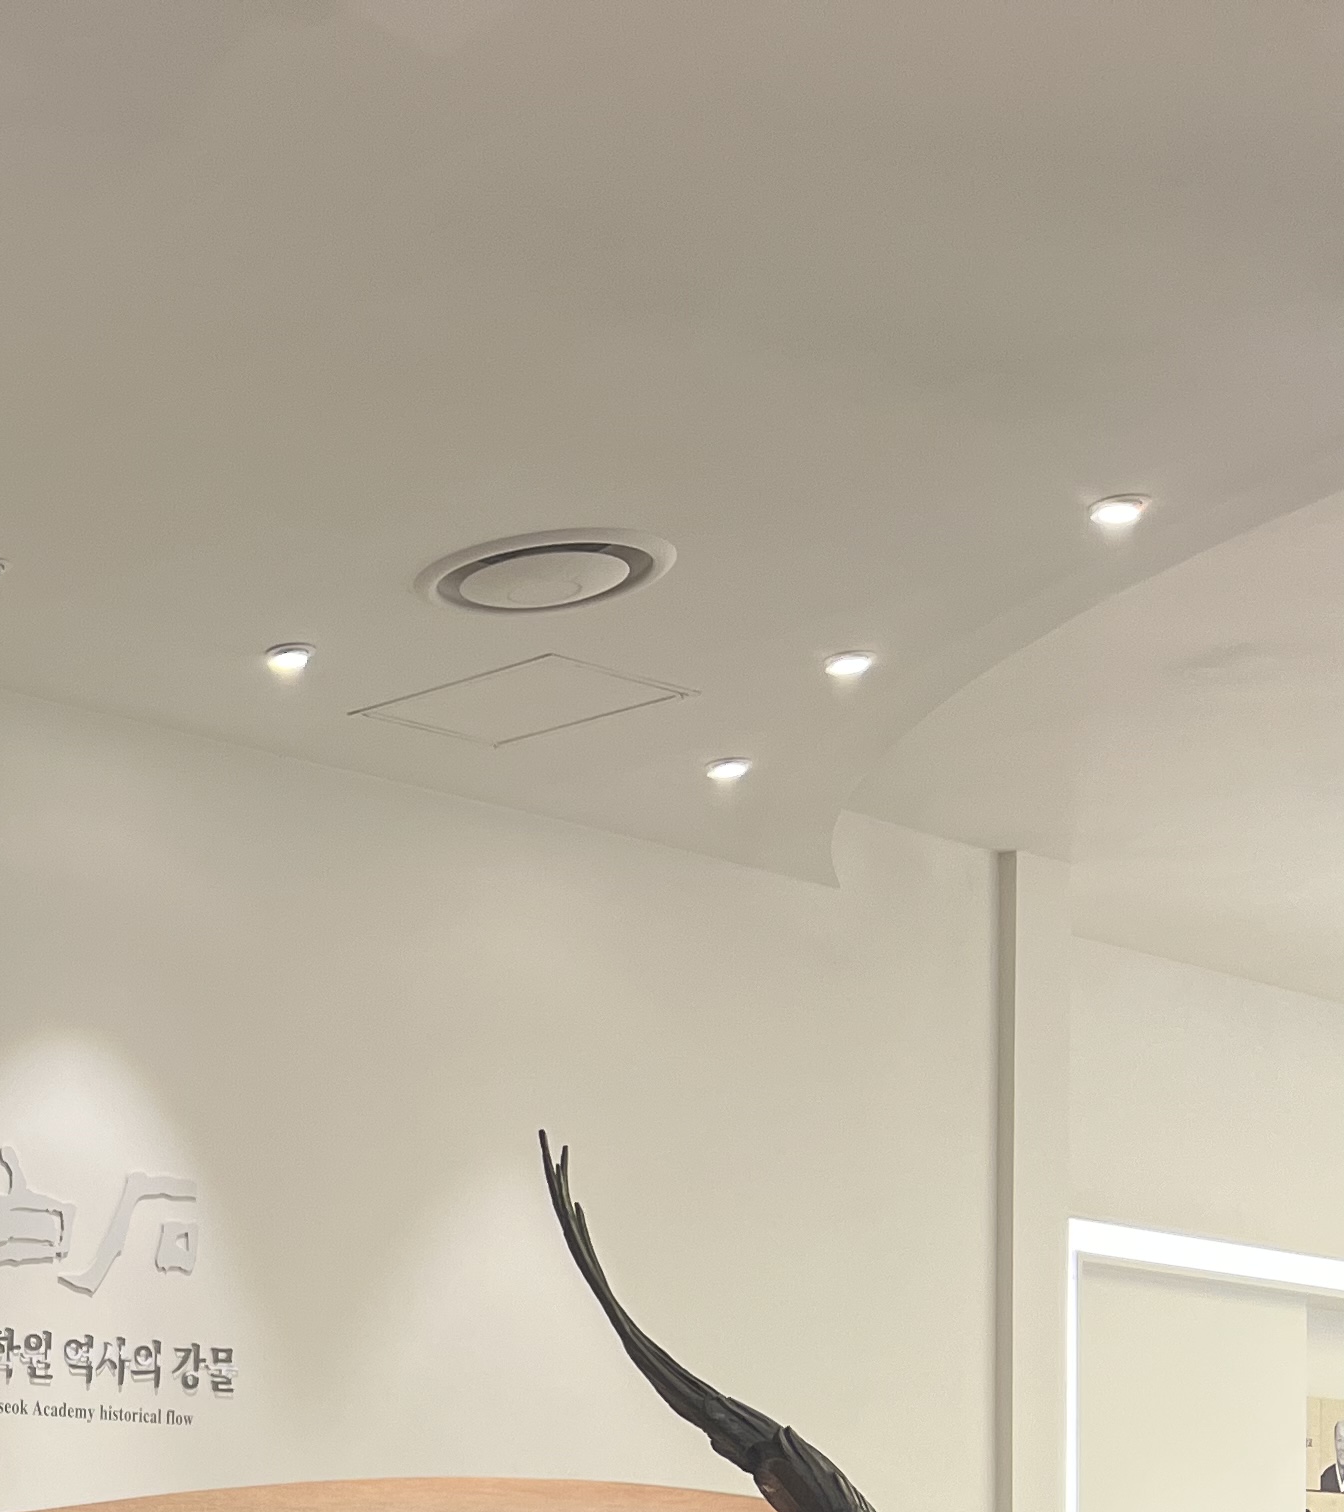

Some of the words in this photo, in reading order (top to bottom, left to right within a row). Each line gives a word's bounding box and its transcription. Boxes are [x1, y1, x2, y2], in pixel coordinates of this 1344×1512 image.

[64, 1333, 161, 1390] 역사의
[172, 1343, 237, 1394] 강물
[32, 1399, 95, 1423] Academy
[99, 1405, 162, 1425] historical
[166, 1409, 194, 1425] flow
